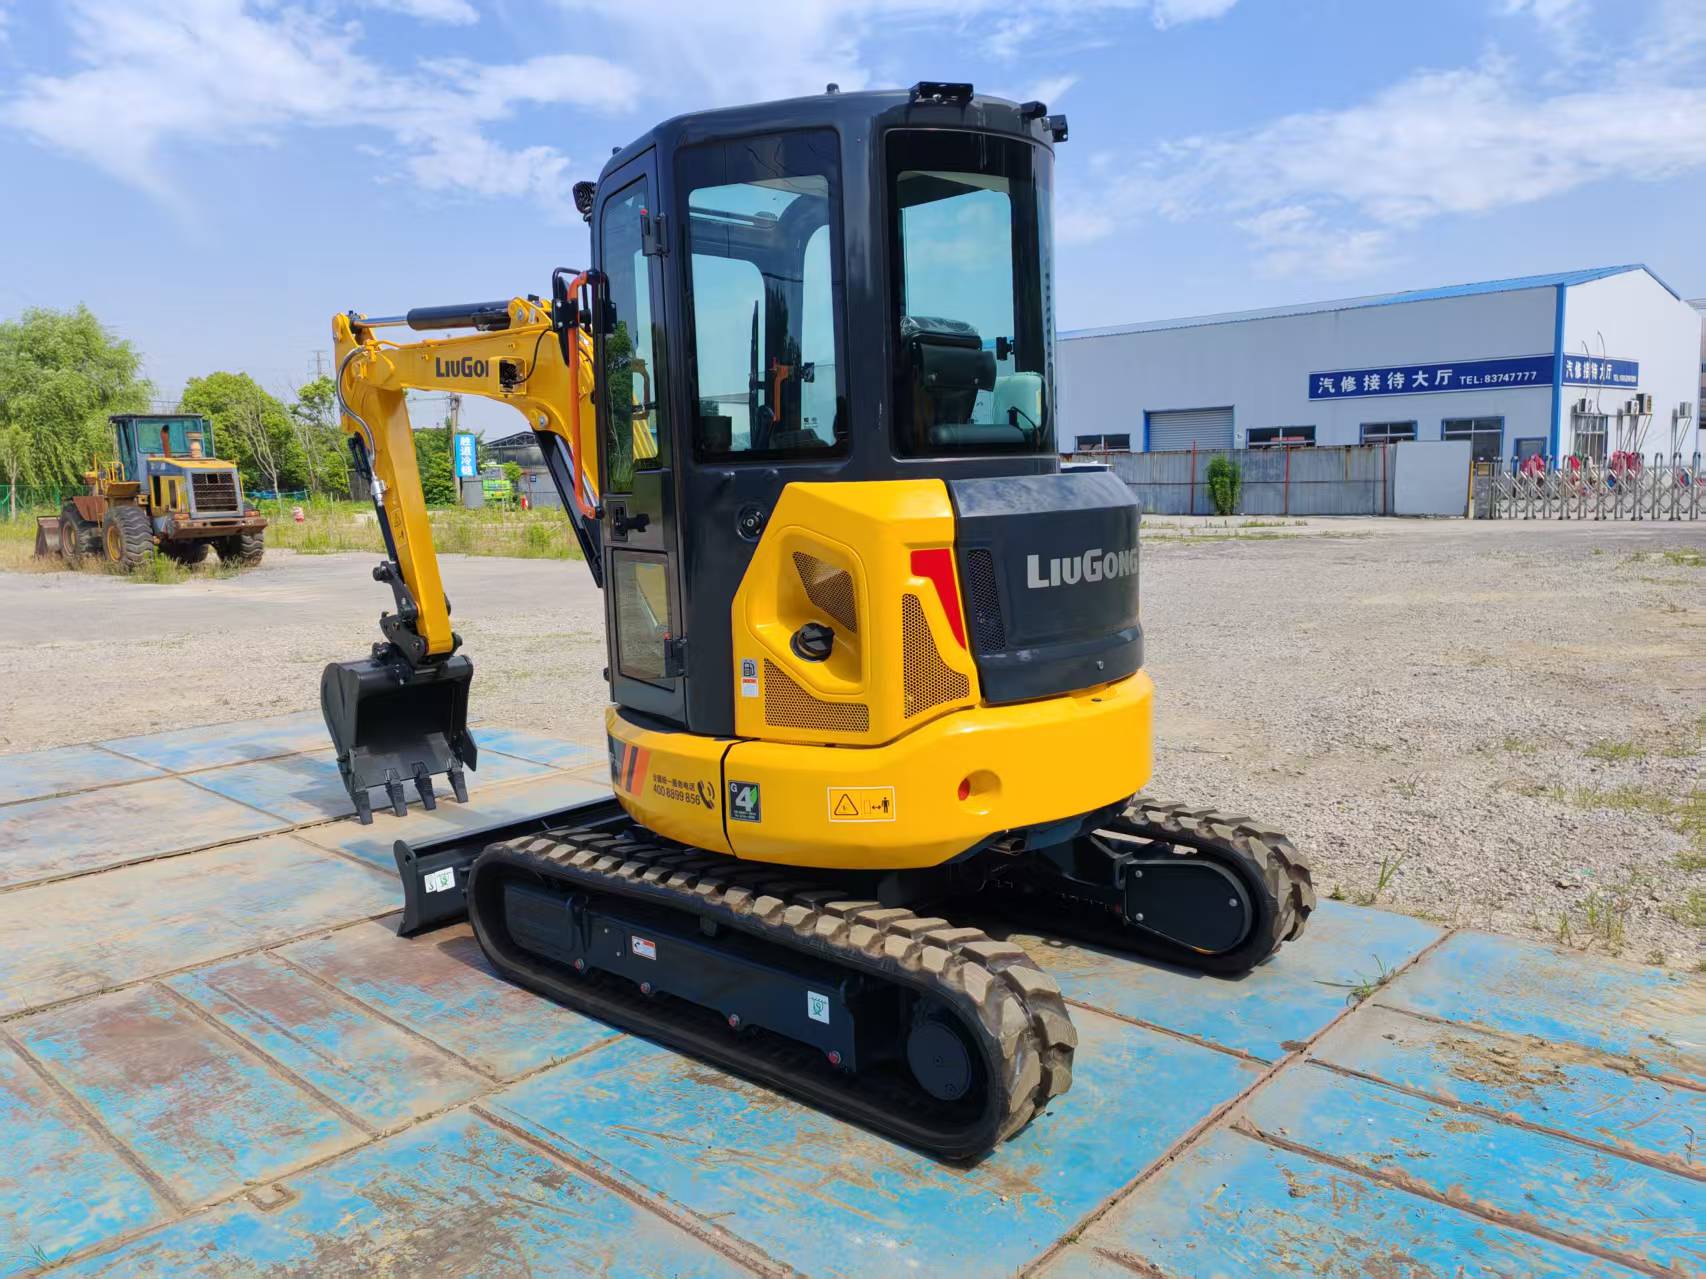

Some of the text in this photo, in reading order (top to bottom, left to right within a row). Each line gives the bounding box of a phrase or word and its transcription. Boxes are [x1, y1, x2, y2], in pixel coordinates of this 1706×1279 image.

[1318, 369, 1537, 394] 汽修接待大厅 TEL:83747777
[653, 784, 666, 797] 400
[685, 792, 701, 806] 856
[735, 786, 753, 812] 4
